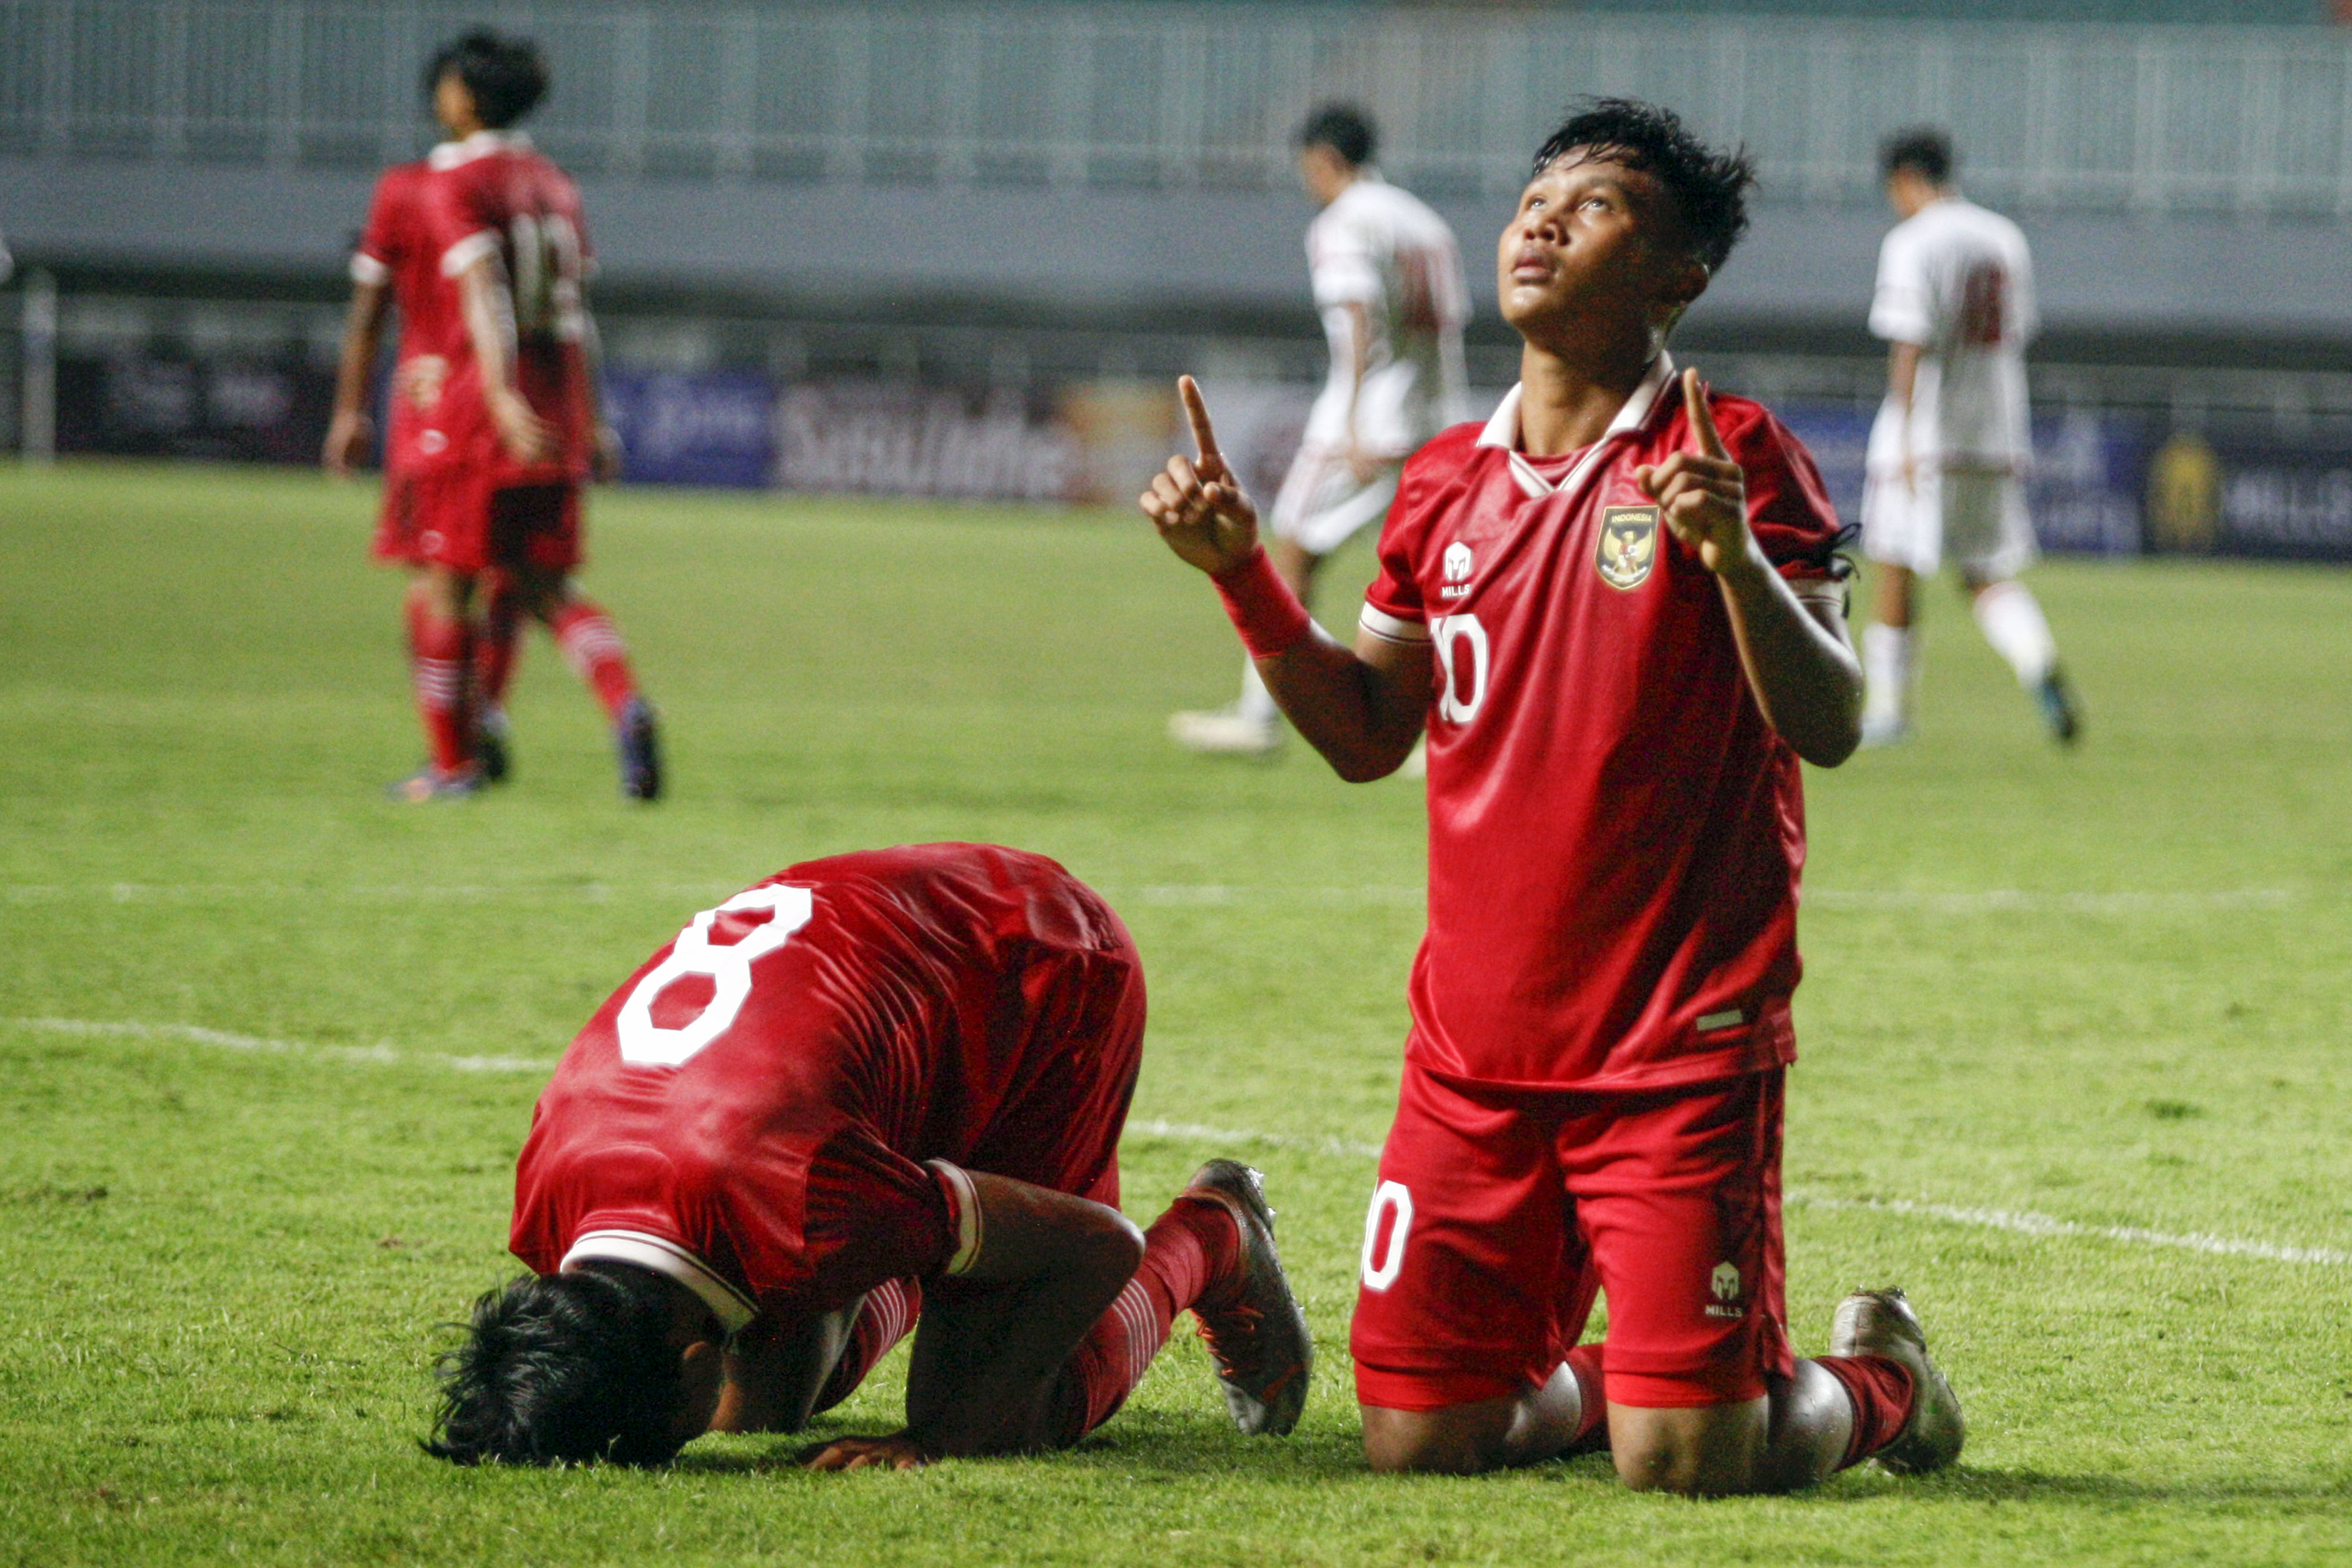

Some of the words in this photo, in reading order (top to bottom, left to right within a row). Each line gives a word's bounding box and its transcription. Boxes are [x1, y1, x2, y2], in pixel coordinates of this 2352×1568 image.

[1612, 513, 1652, 523] INDONESIA
[1442, 584, 1470, 597] MILLS
[617, 883, 813, 1066] 8
[1361, 1176, 1412, 1290] 0
[1705, 1305, 1742, 1317] MILLS
